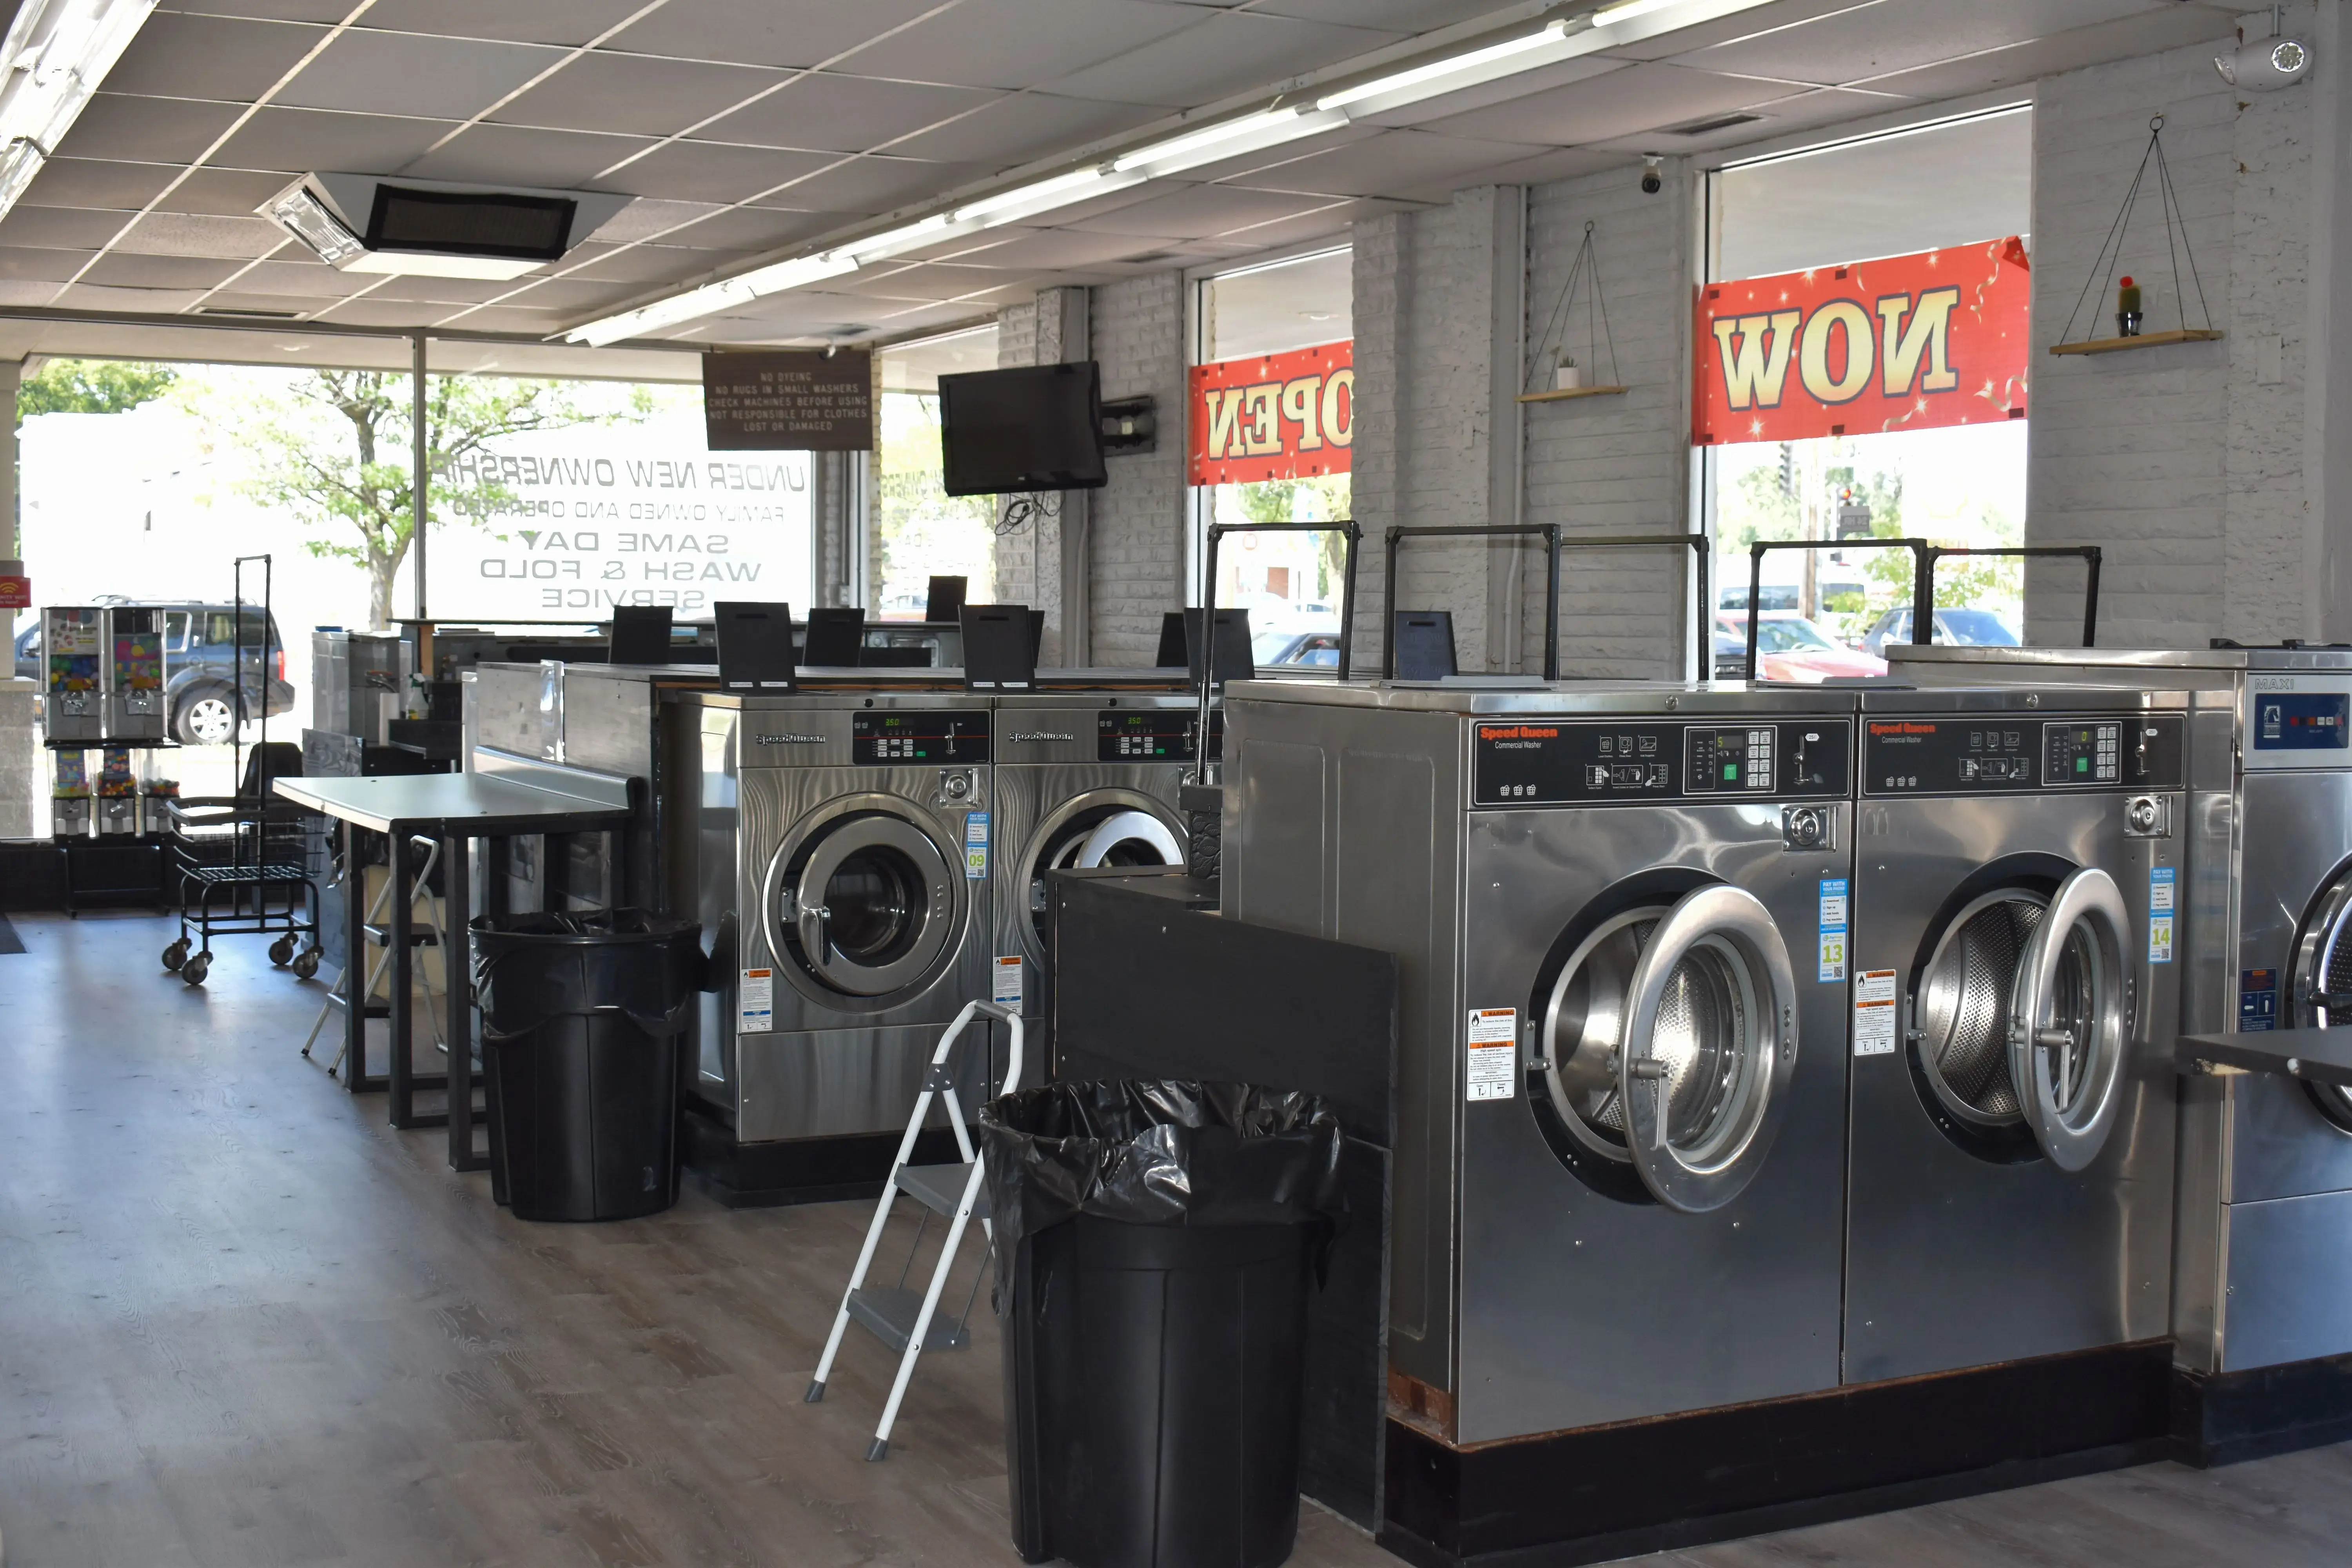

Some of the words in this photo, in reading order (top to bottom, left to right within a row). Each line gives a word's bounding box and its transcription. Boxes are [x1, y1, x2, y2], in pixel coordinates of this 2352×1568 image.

[760, 372, 773, 382] NO
[778, 372, 812, 382] DYEING
[715, 385, 728, 395] NO
[762, 385, 772, 394] IN
[778, 385, 808, 394] SMALL
[813, 383, 858, 393] WASHERS
[708, 397, 739, 407] CHECK
[744, 397, 791, 407] MACHINES
[797, 396, 833, 406] BEFORE
[838, 396, 867, 406] USING
[710, 410, 727, 419] NOT
[731, 409, 796, 419] RESPONSIBLE
[801, 409, 819, 418] FOR
[824, 408, 867, 418] CLOTHES
[744, 422, 767, 431] LOST
[771, 422, 784, 431] OR
[789, 421, 833, 431] DAMAGED
[2255, 679, 2294, 690] MAXI
[1480, 726, 1519, 740] Speed
[1520, 726, 1558, 737] Queen
[1870, 722, 1902, 736] Speed
[1904, 722, 1936, 733] Queen
[756, 734, 791, 746] Speed
[791, 733, 826, 743] Queen
[1009, 731, 1041, 743] Speed
[1041, 731, 1073, 741] Queen
[969, 855, 985, 866] 09
[2152, 928, 2170, 945] 14
[1823, 944, 1842, 963] 13
